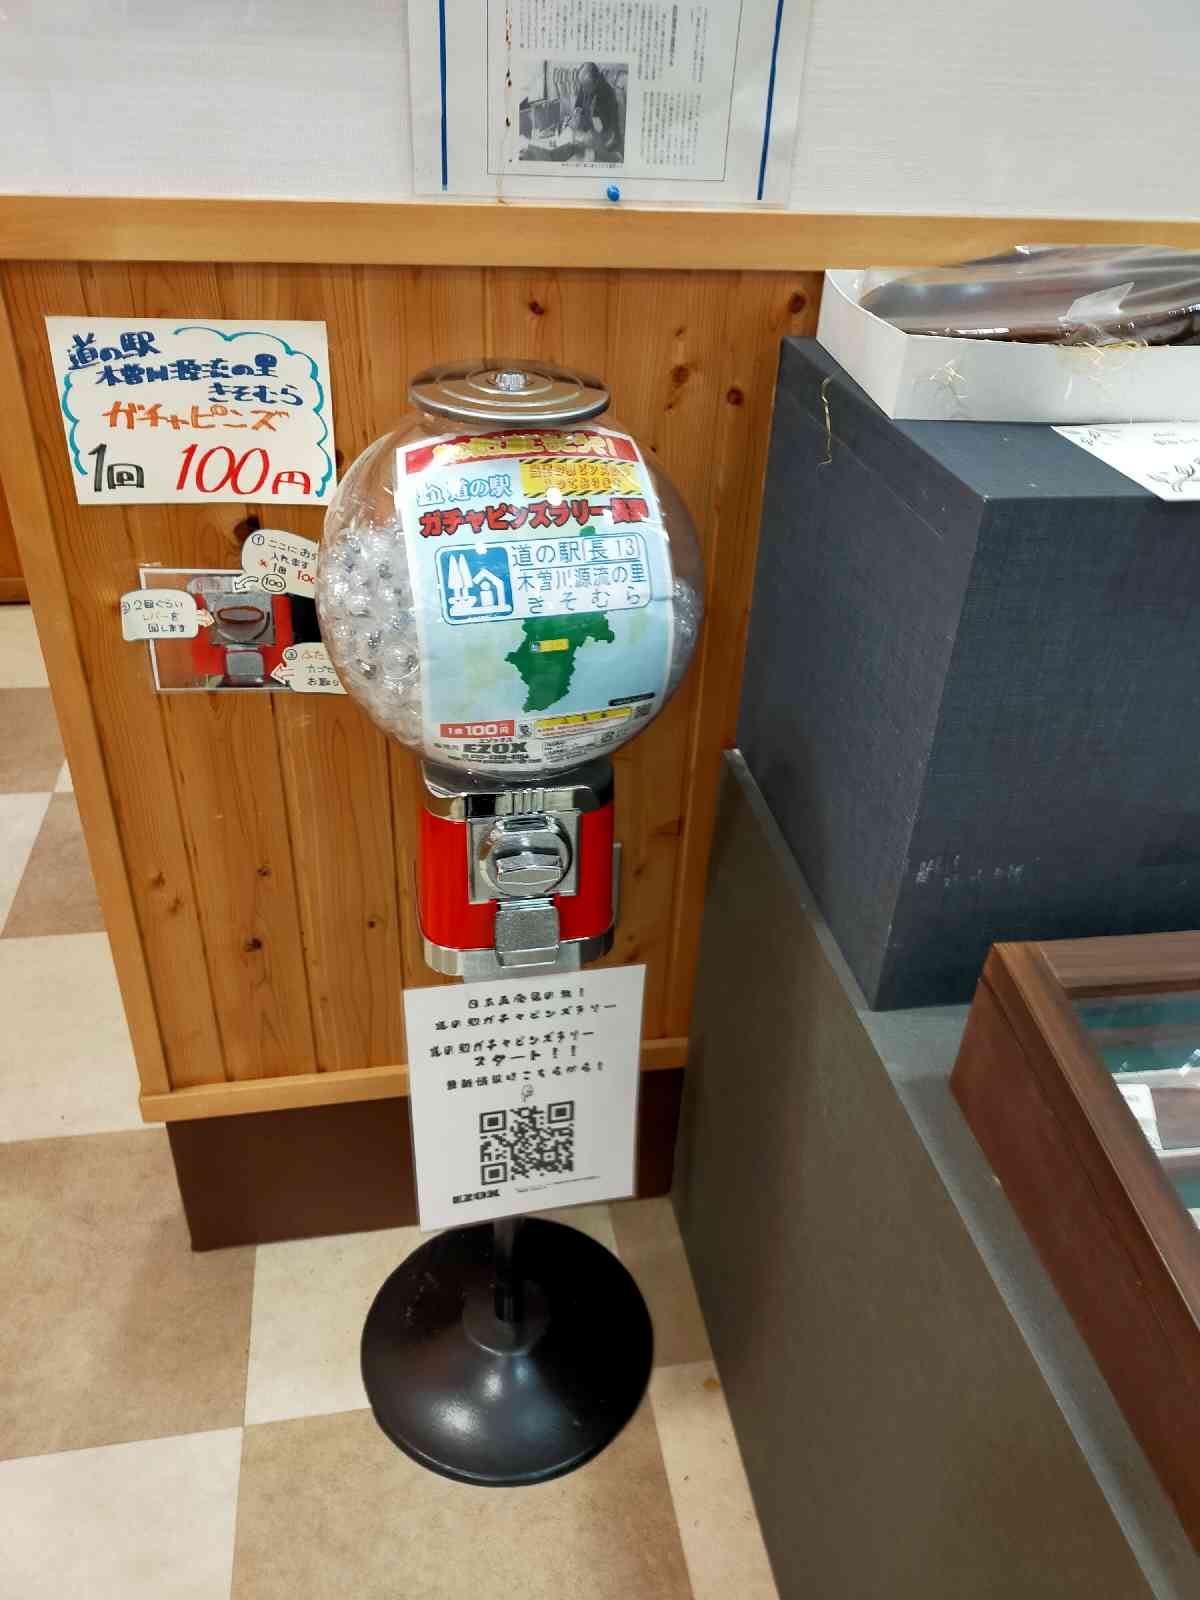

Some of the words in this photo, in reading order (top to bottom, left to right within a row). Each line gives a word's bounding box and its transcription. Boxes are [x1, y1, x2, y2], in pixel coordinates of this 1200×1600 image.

[67, 331, 161, 371] 道の駅
[208, 382, 304, 406] きそむら
[102, 400, 290, 432] ガチャピンズ
[88, 443, 145, 492] 1回
[175, 443, 311, 495] 100円
[512, 541, 580, 568] 道の駅
[528, 585, 642, 615] きそむら
[452, 1189, 501, 1205] EZOX
